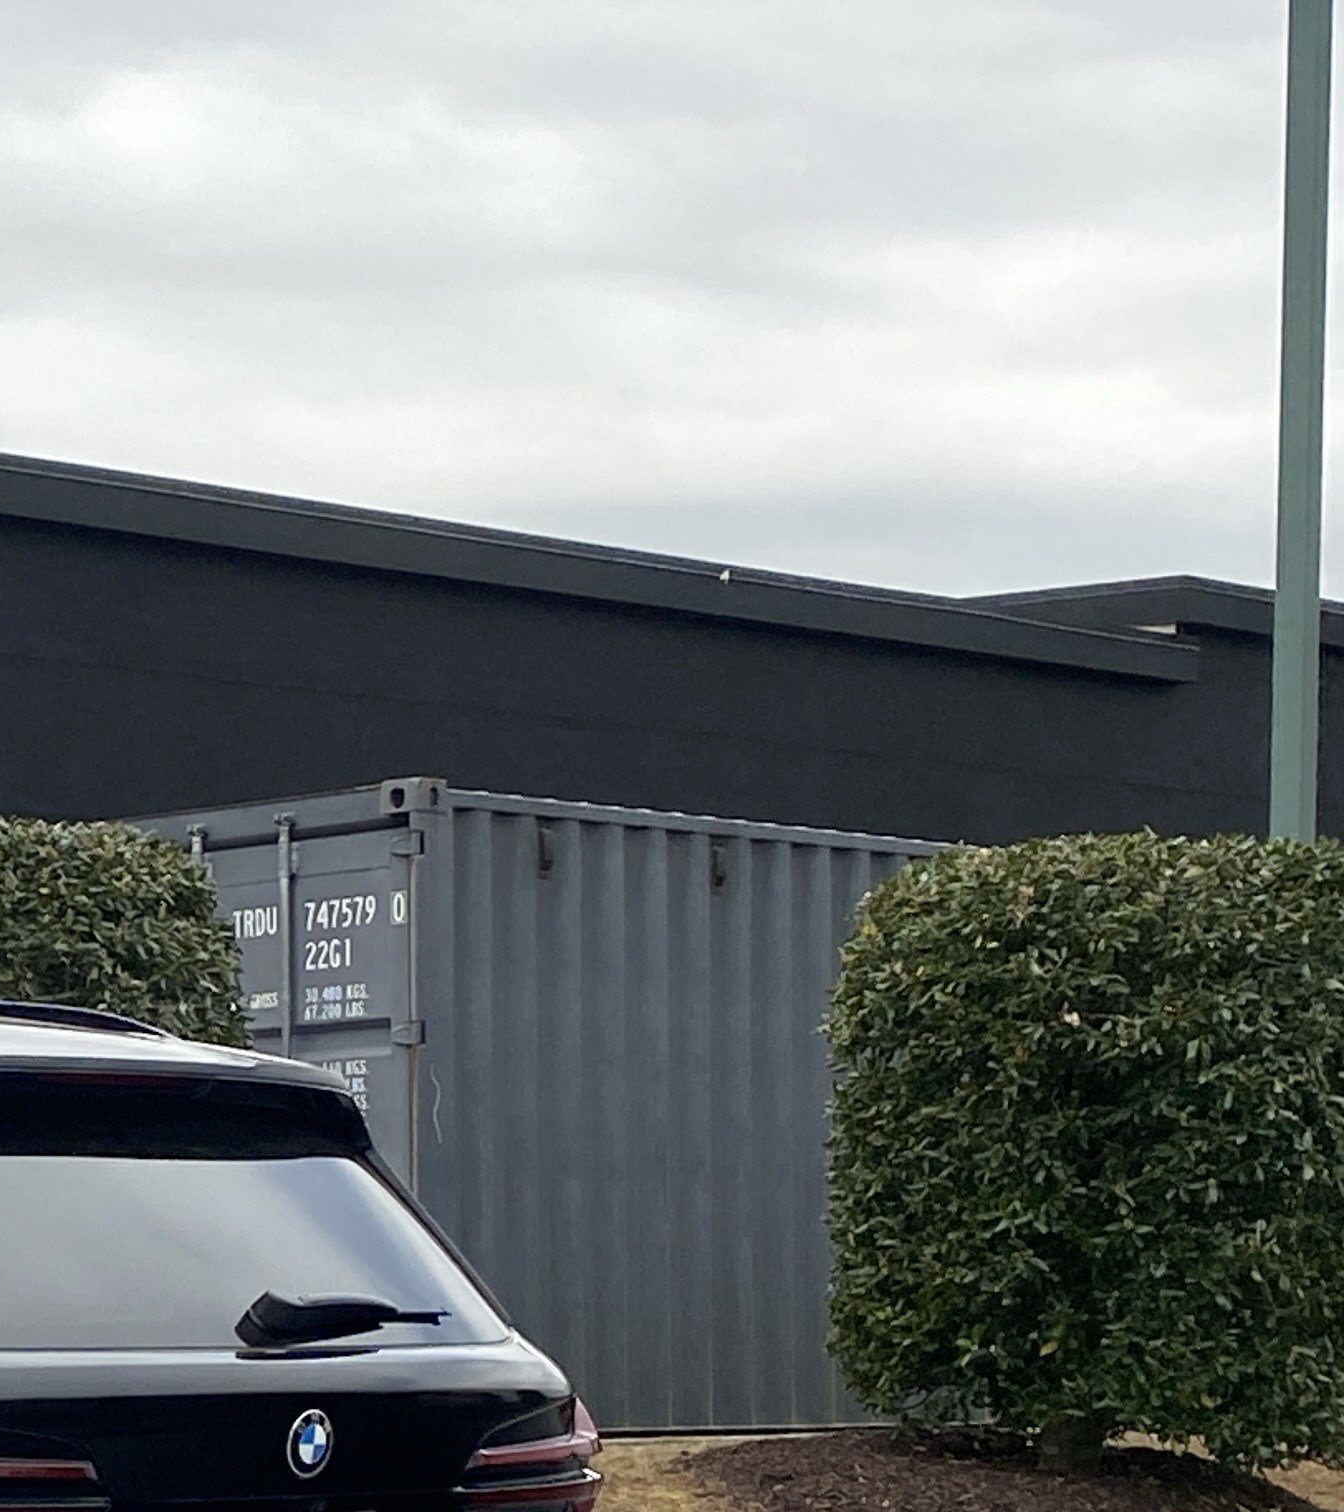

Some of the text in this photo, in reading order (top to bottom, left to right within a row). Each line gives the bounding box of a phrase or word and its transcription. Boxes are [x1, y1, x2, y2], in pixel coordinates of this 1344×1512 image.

[232, 892, 405, 938] TRDU 747579 0
[305, 938, 351, 971] 22G1
